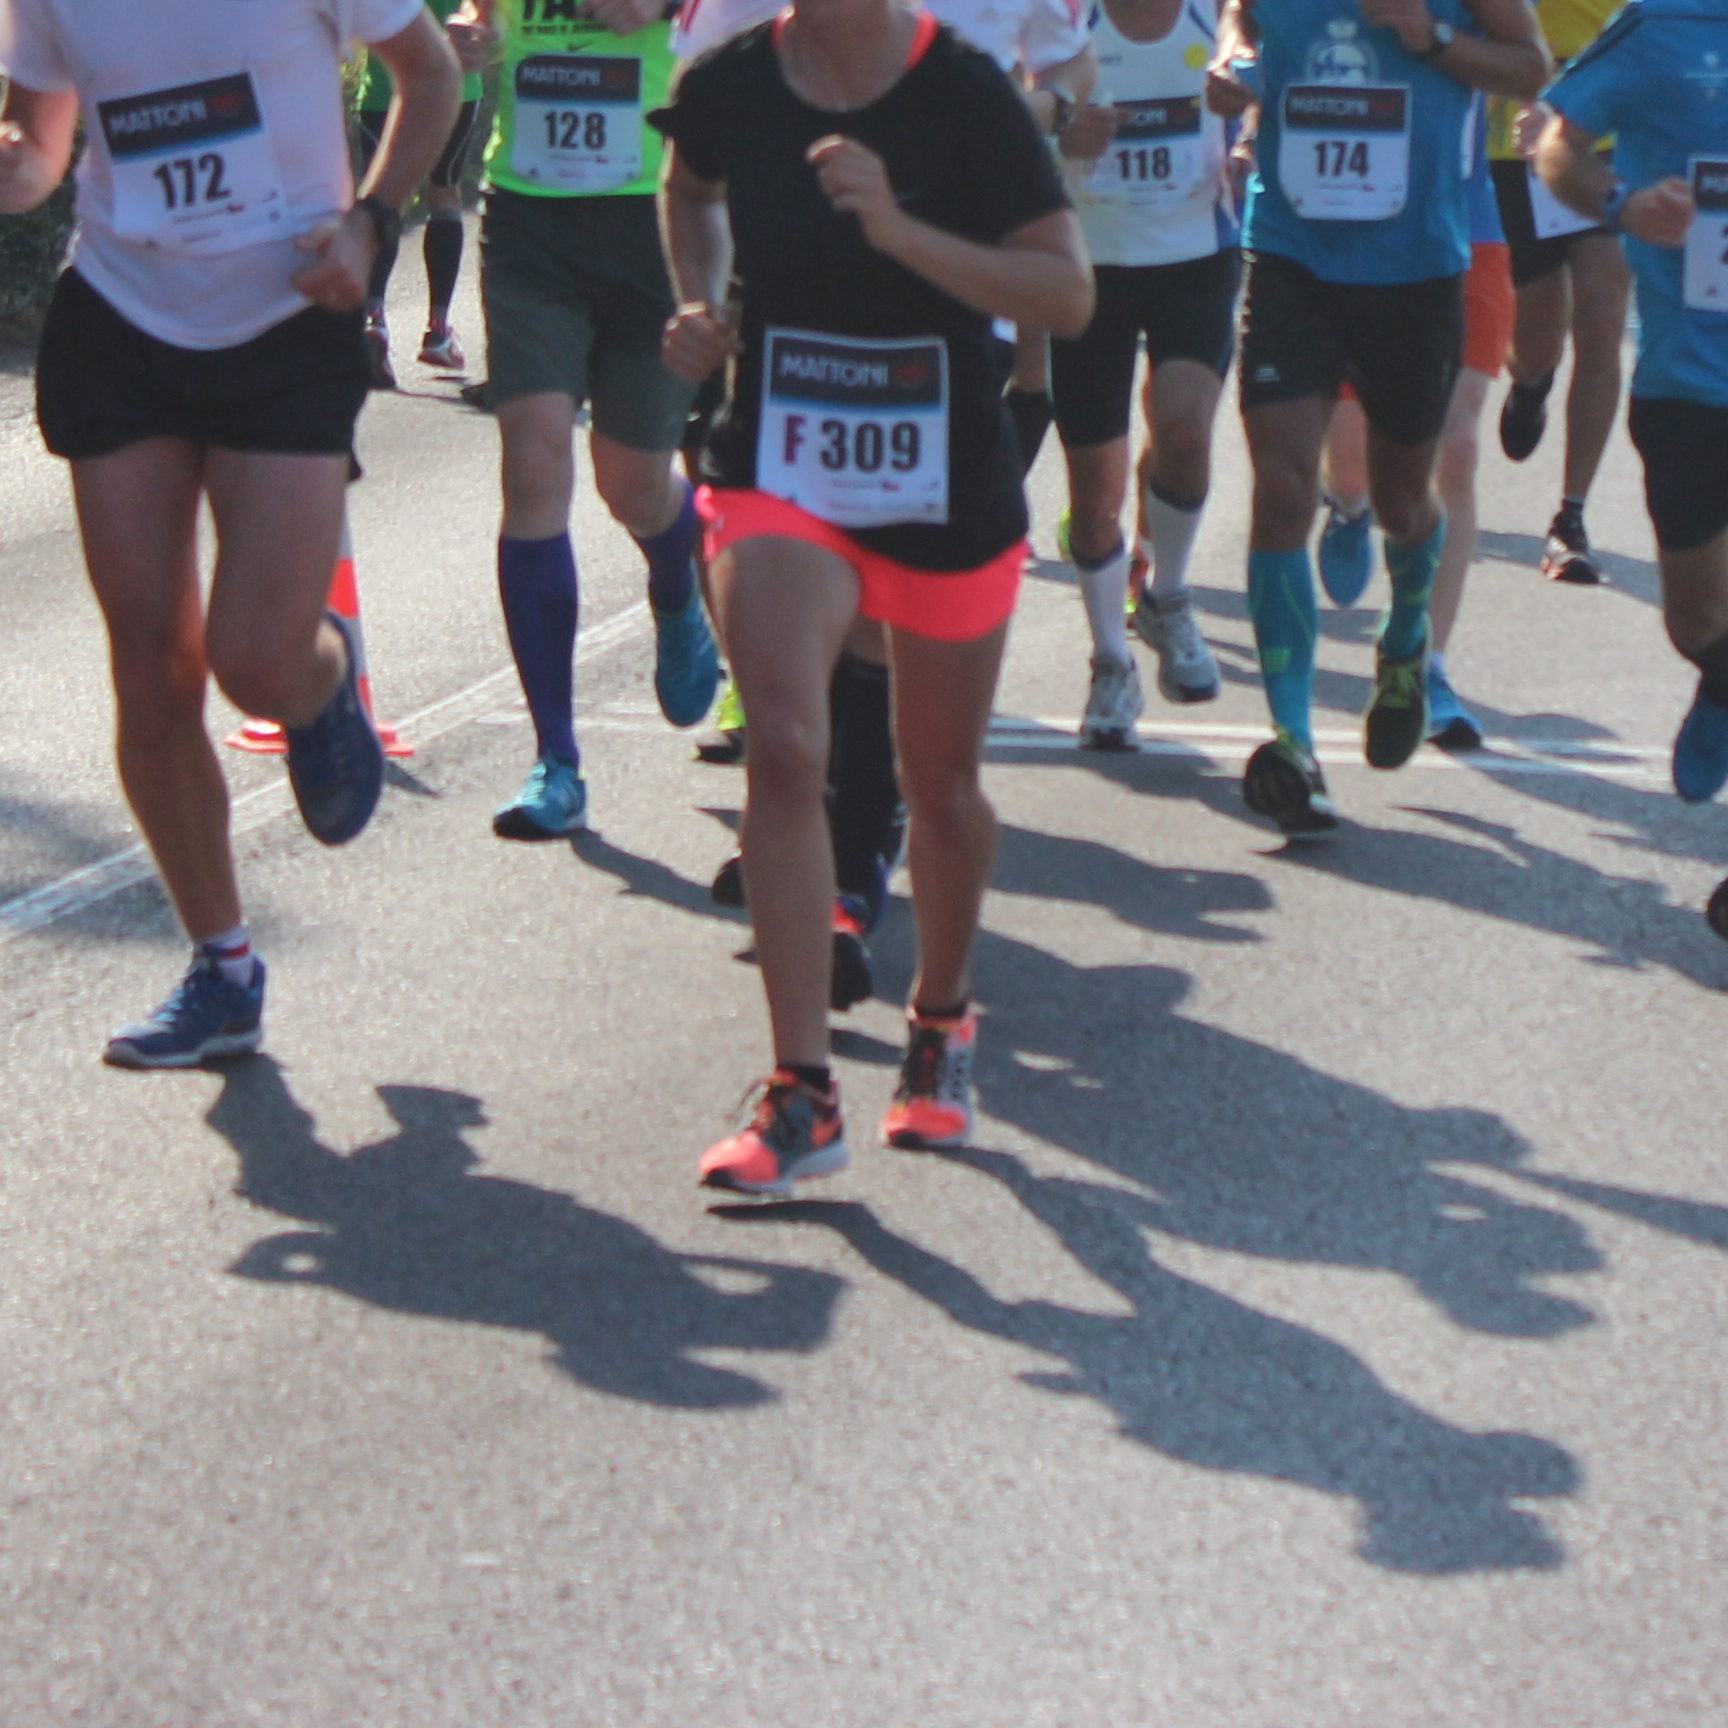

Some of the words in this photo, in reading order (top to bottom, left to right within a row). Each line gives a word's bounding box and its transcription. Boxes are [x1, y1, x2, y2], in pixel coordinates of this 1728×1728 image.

[523, 66, 601, 86] MATTONI
[108, 96, 208, 136] MATTONI
[544, 110, 606, 151] 128
[1116, 146, 1171, 181] 118
[1314, 140, 1369, 179] 174
[153, 152, 232, 210] 172
[779, 352, 889, 388] MATTONI
[820, 419, 920, 473] 309
